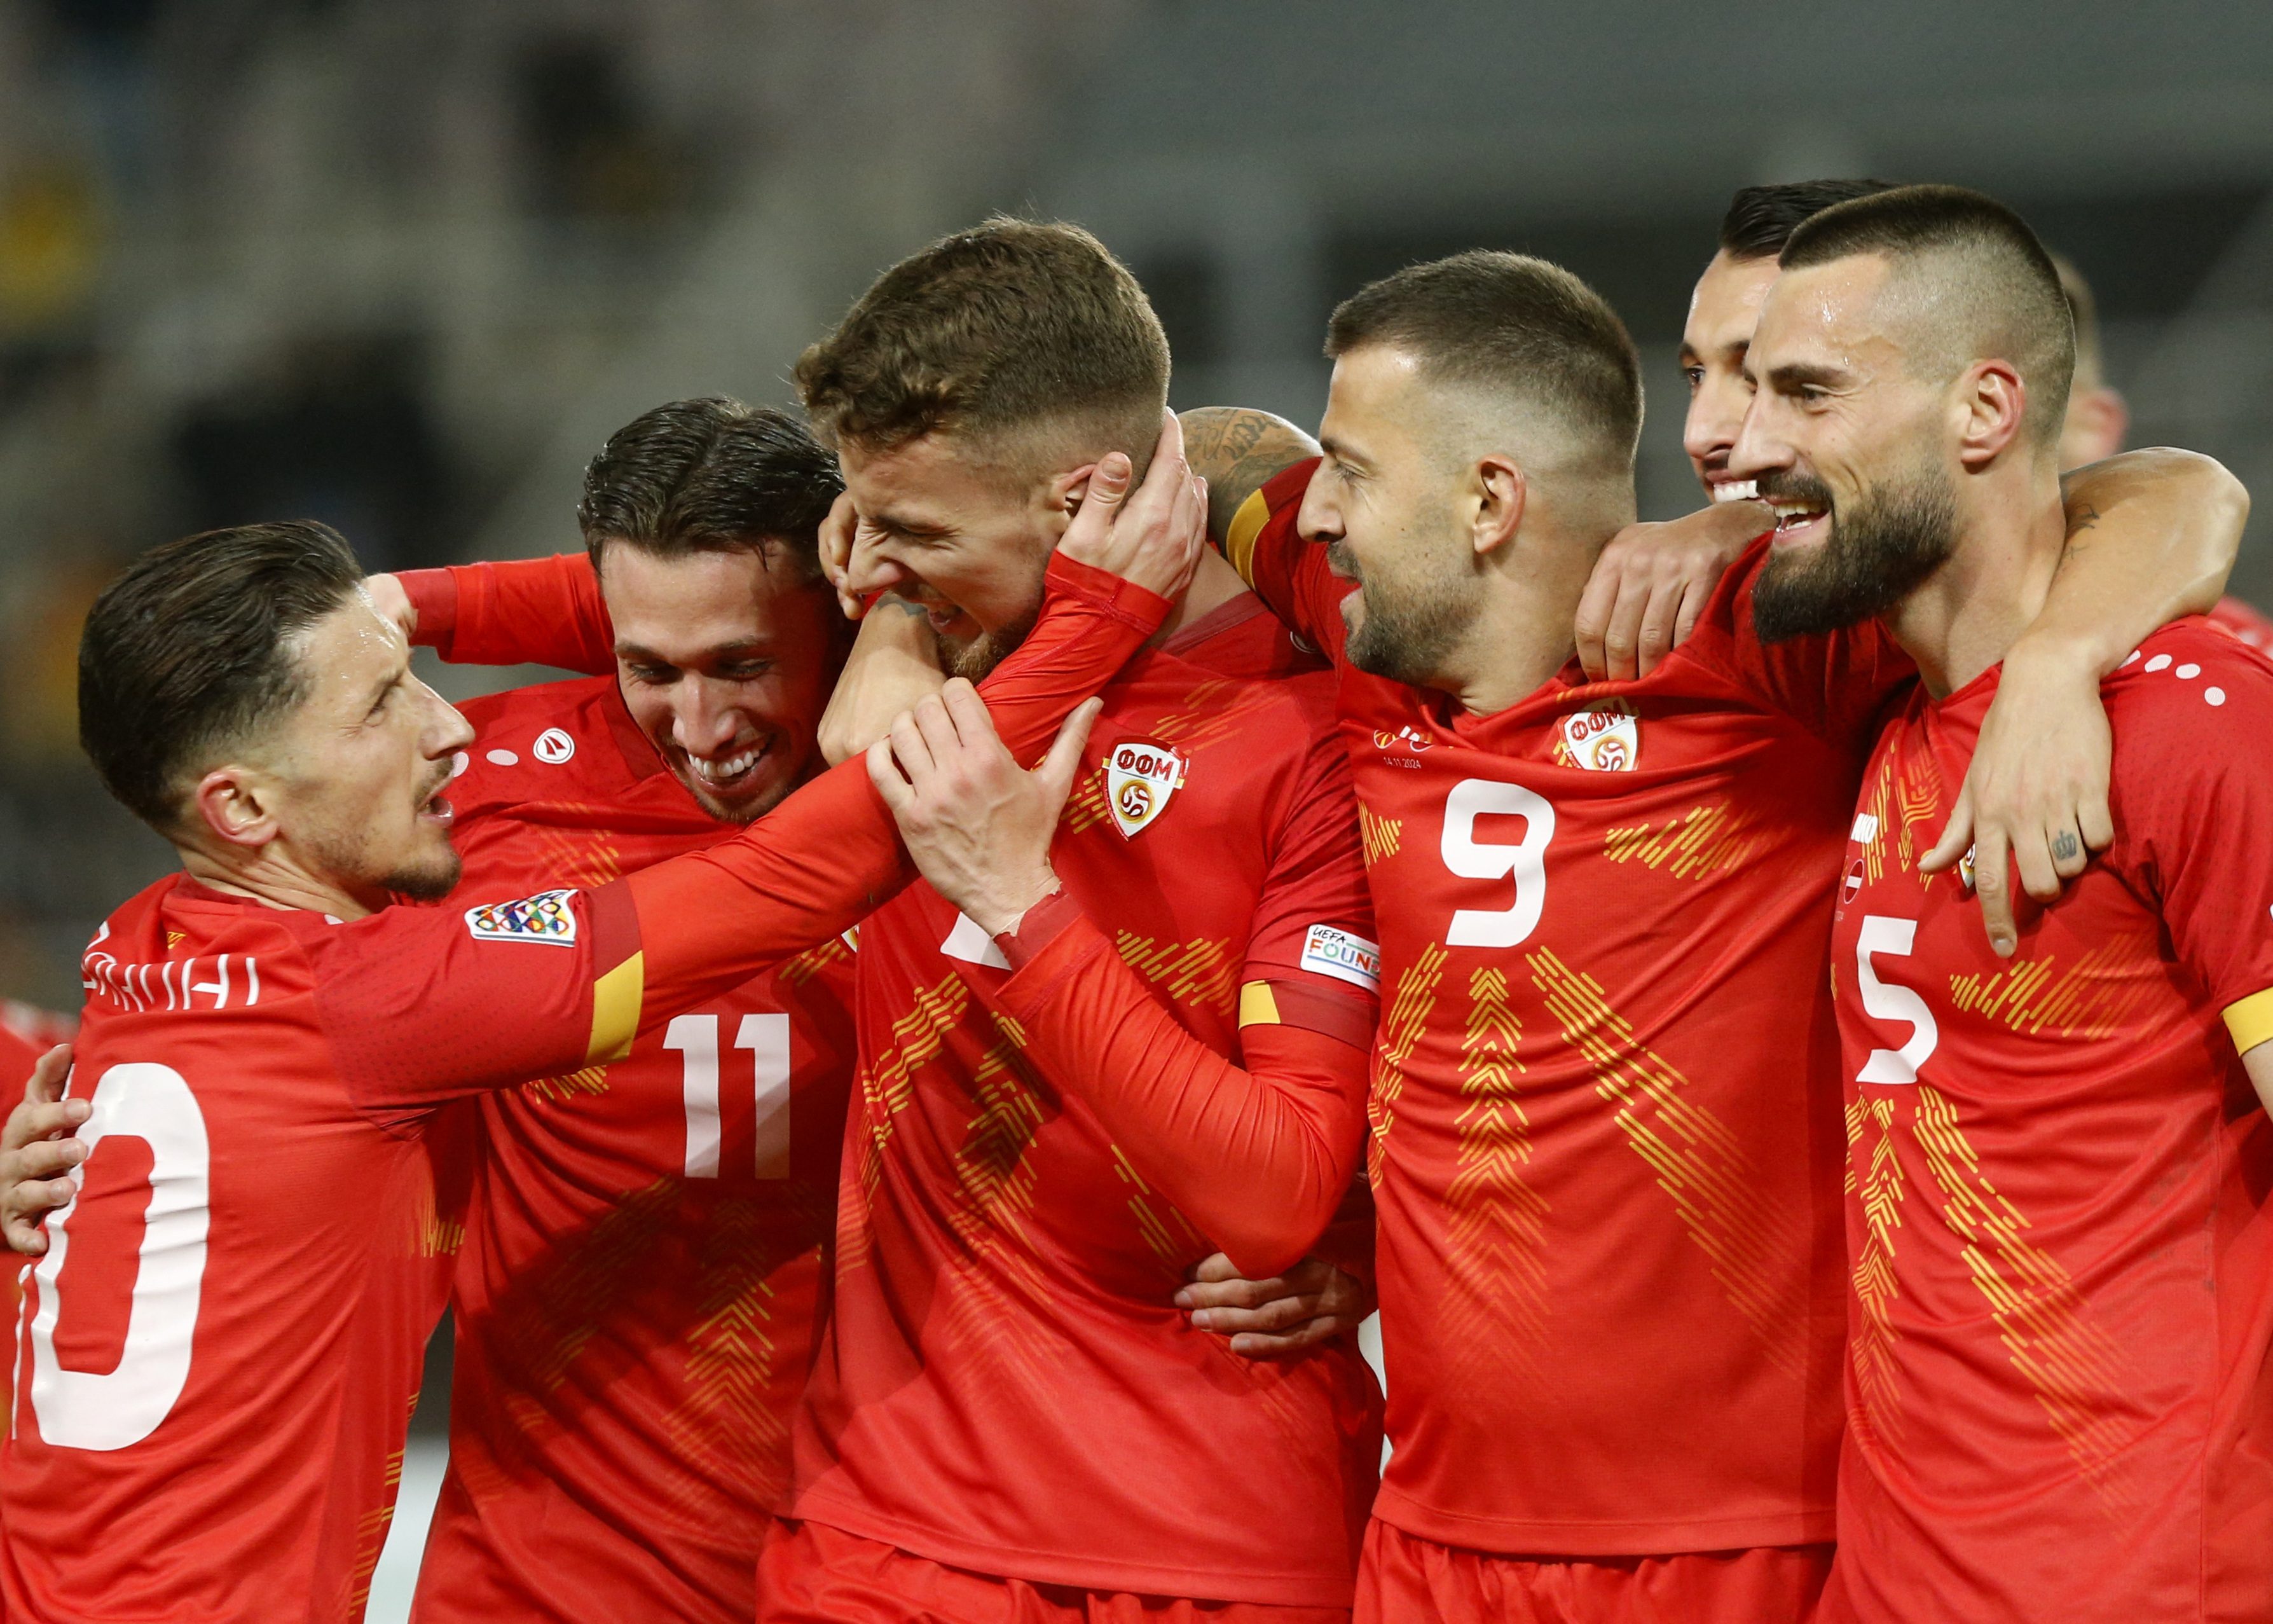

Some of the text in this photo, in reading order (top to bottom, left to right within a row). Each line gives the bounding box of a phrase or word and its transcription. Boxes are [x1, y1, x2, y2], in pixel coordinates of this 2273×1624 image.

[1117, 749, 1174, 781] ФФМ
[1383, 757, 1422, 769] 14.11.2024
[1441, 778, 1556, 947] 9
[1313, 926, 1346, 944] UEFA
[1856, 915, 1938, 1084] 5
[662, 1013, 790, 1180] 11
